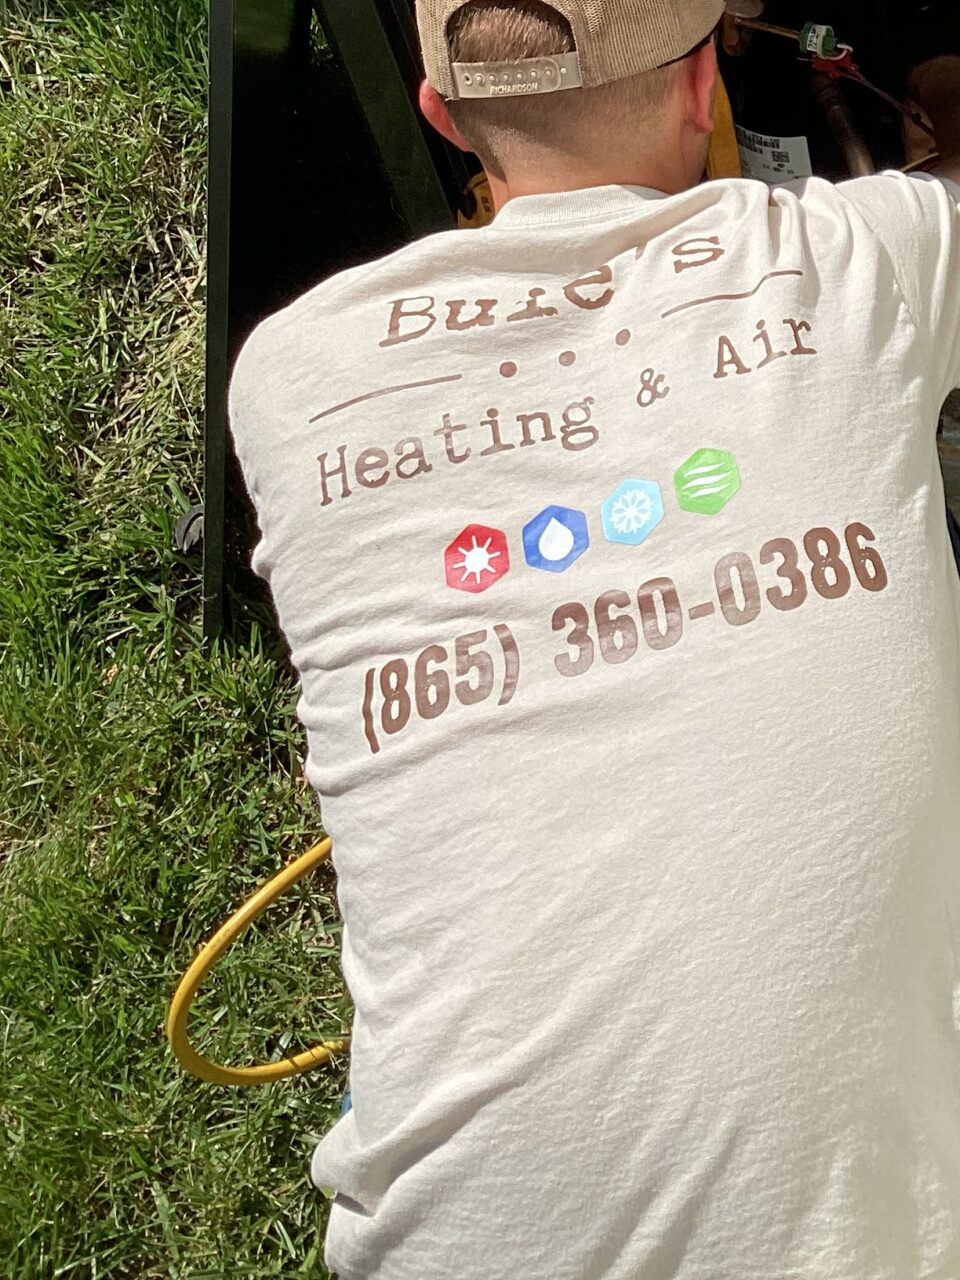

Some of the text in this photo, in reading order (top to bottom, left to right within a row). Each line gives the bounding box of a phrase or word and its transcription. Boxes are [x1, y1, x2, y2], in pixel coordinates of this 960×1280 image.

[489, 82, 538, 95] RICHARDSON
[317, 317, 818, 506] Heating & Air
[361, 521, 889, 754] (865) 360-0386
